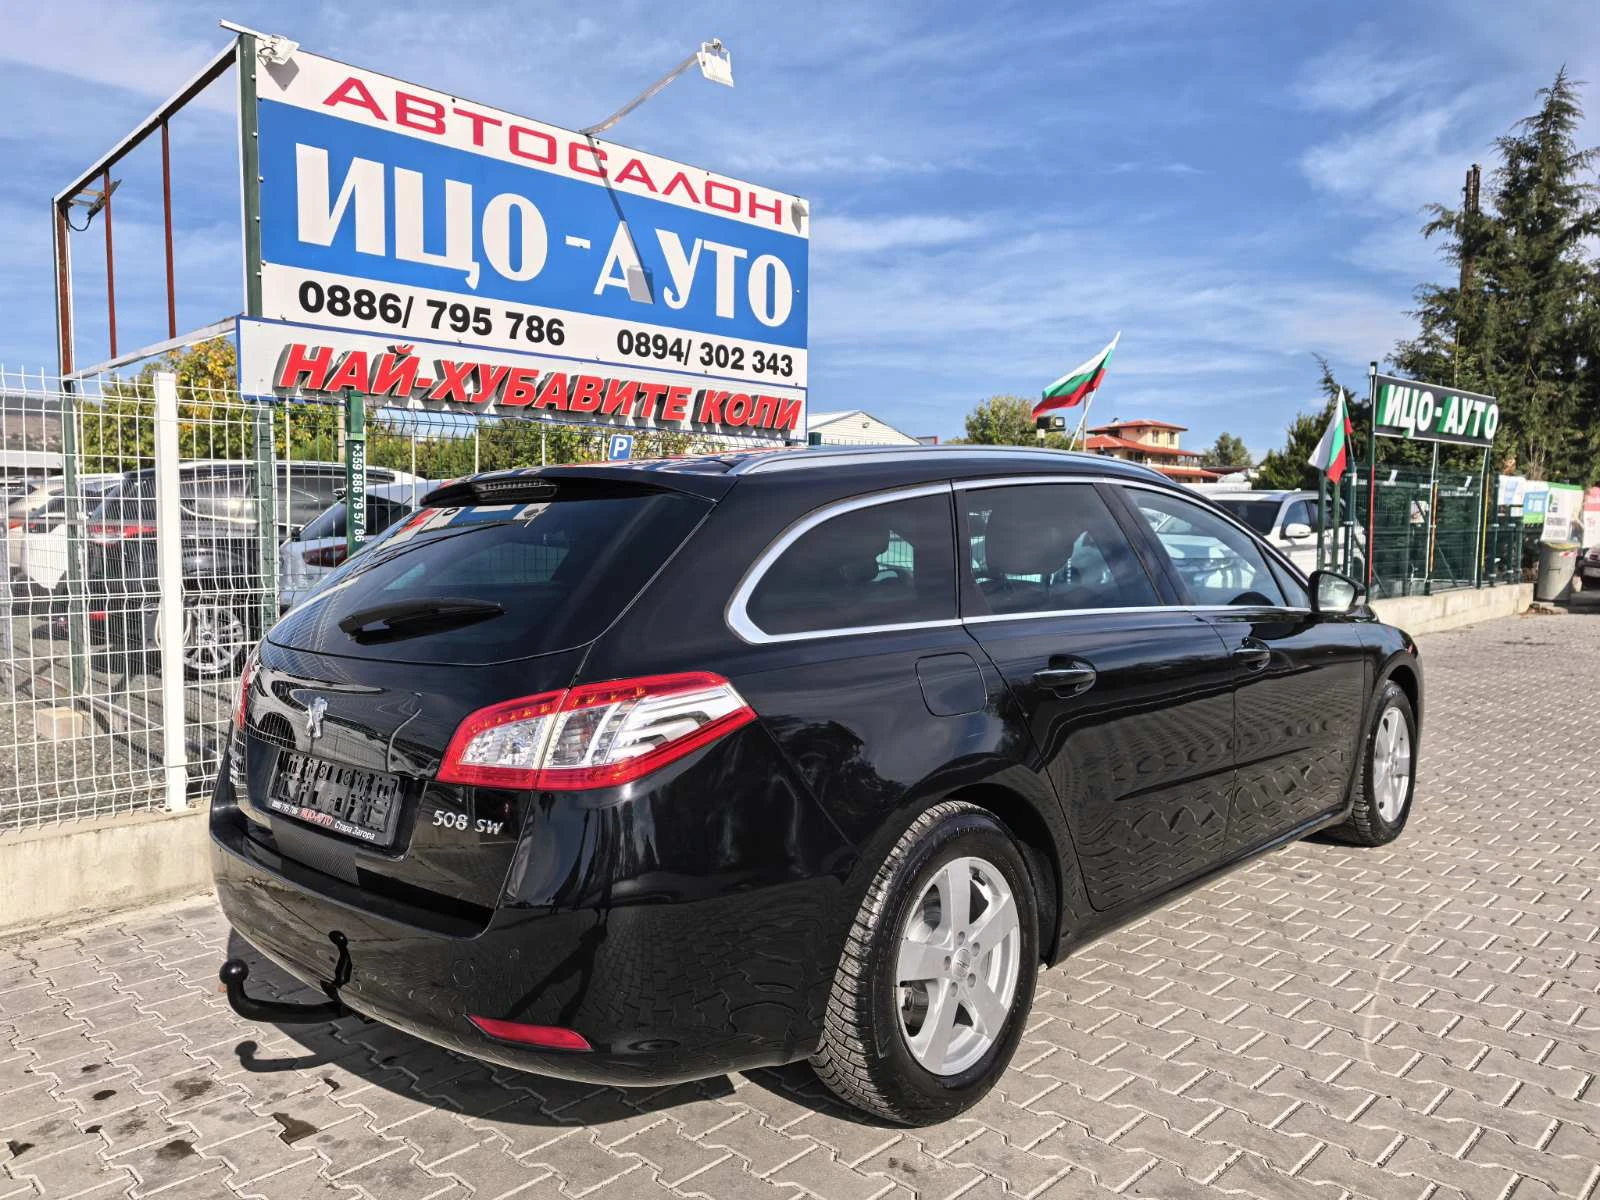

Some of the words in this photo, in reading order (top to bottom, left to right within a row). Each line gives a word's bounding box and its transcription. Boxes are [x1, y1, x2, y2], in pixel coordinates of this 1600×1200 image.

[322, 76, 782, 226] АВТОСАЛОН
[298, 280, 414, 328] 0886/
[426, 299, 493, 336] 795
[505, 311, 566, 346] 786
[616, 329, 692, 366] 0894/
[699, 342, 745, 371] 302
[752, 350, 793, 377] 343
[277, 343, 692, 422] НАЙ-ХУБАВИТЕ
[699, 389, 802, 431] КОЛИ
[1382, 384, 1499, 440] ИЦО-АУТО
[352, 443, 364, 470] +359
[613, 438, 628, 457] P
[352, 473, 364, 493] 886
[353, 496, 364, 510] 79
[353, 512, 365, 526] 57
[354, 528, 366, 542] 86
[334, 820, 353, 833] Стара
[352, 826, 376, 841] Загора
[432, 809, 469, 831] 508
[474, 818, 504, 836] SW
